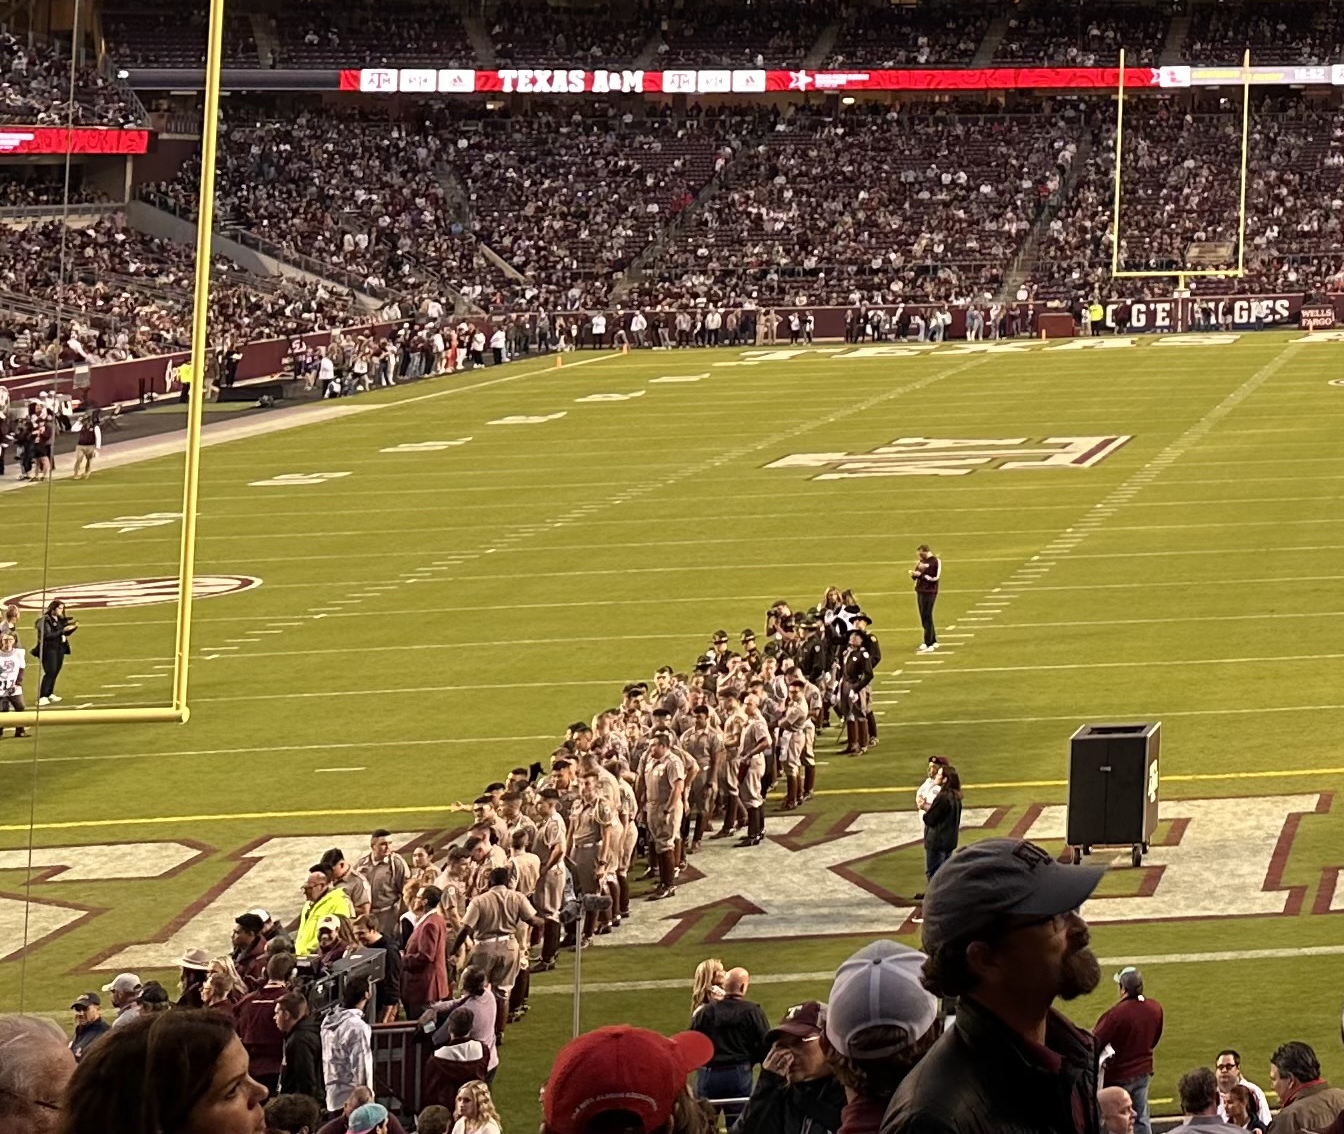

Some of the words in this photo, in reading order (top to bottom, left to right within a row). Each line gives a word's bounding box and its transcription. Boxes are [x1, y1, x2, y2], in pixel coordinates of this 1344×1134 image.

[498, 69, 586, 93] TEXAS
[591, 70, 644, 93] A&M
[1301, 308, 1332, 317] WELLS
[1301, 317, 1333, 327] FARGO
[741, 334, 1242, 362] TEXAS
